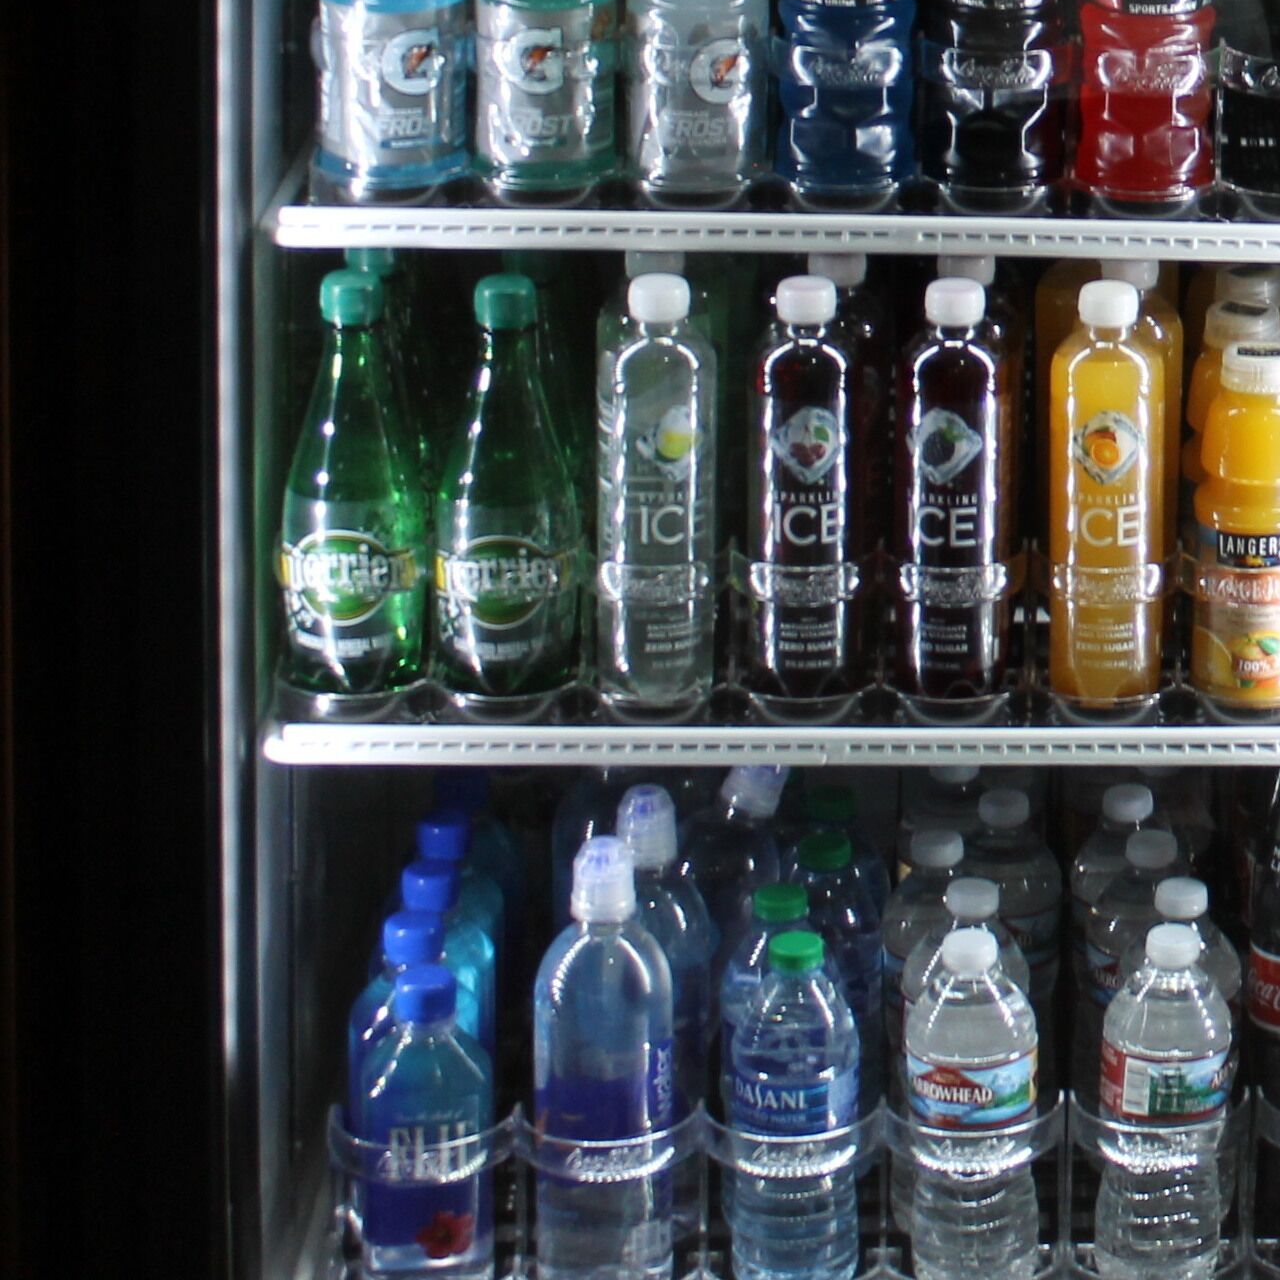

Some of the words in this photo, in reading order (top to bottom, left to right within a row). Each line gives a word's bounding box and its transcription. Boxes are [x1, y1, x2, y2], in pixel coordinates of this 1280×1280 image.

[774, 491, 839, 502] SPARKLIN
[774, 505, 839, 545] ICE
[1079, 505, 1141, 547] CE
[736, 1080, 808, 1110] DASANI
[913, 1075, 993, 1105] ARROWHEAD
